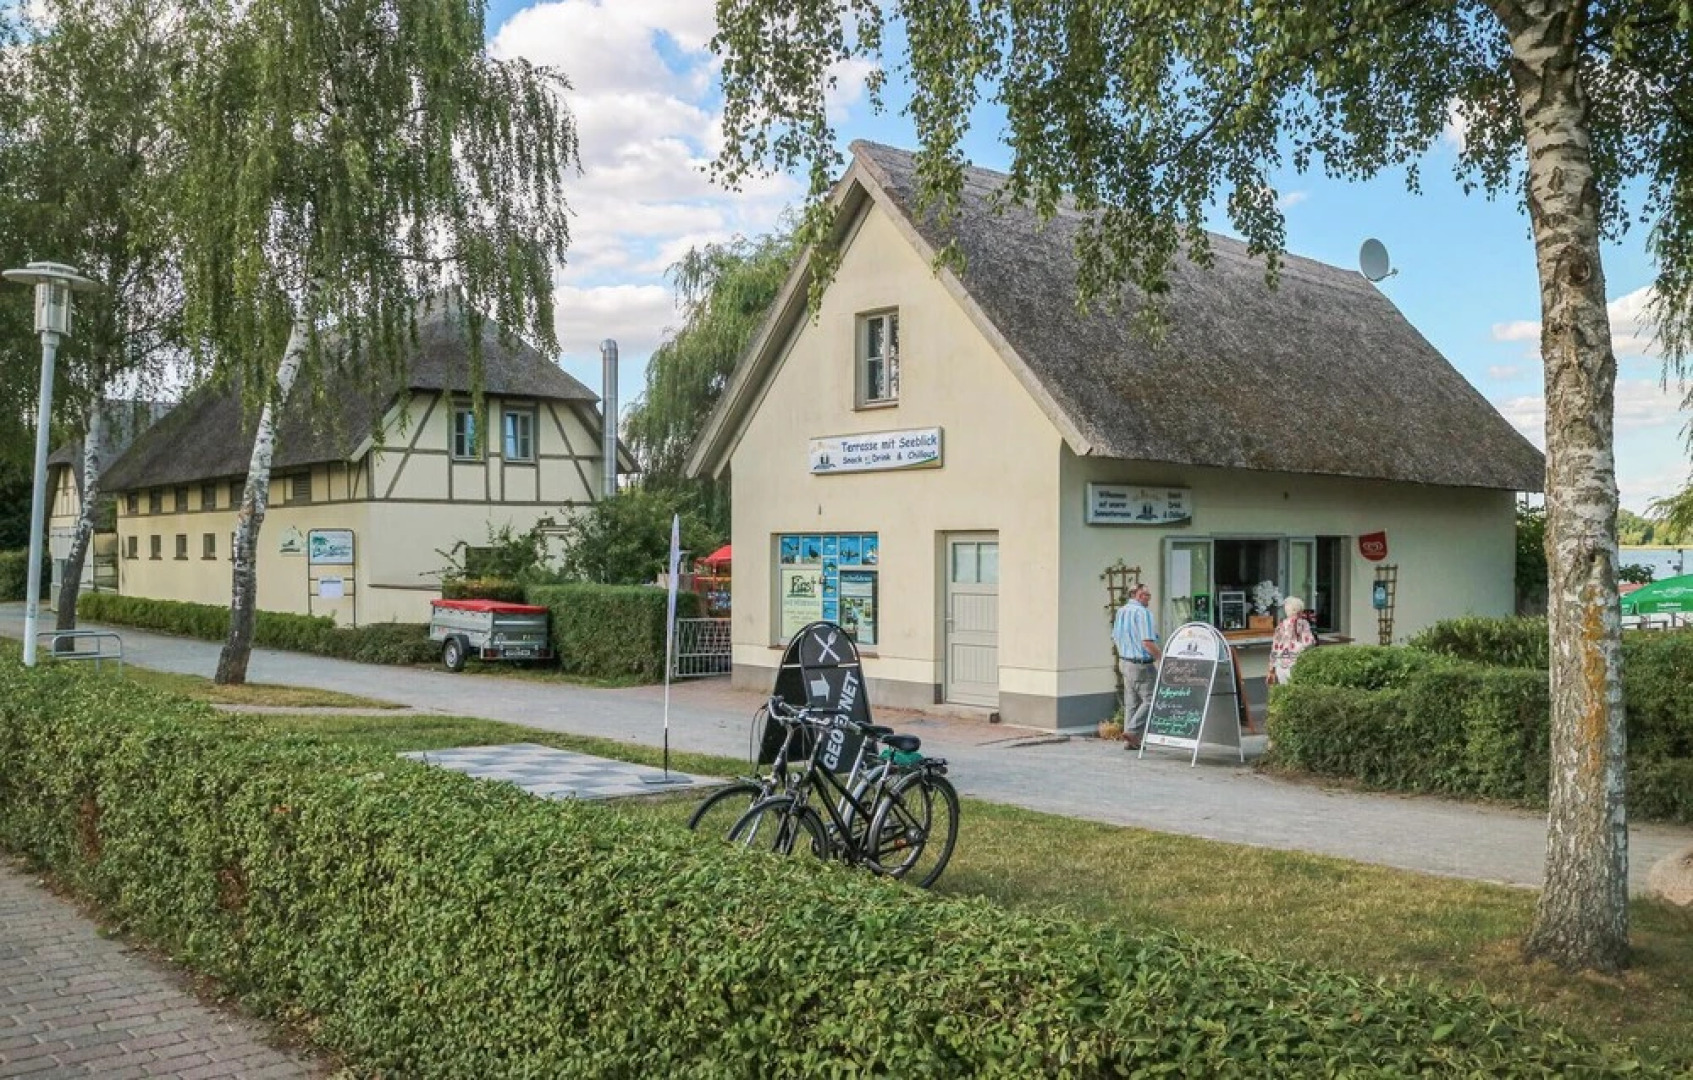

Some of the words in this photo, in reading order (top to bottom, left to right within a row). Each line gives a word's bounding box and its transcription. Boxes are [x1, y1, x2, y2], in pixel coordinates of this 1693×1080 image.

[841, 441, 878, 452] Terrasse
[882, 439, 894, 449] mit
[899, 435, 937, 448] Seeblick
[843, 456, 863, 465] Snack
[872, 454, 891, 462] Drink
[908, 450, 936, 459] Chillout
